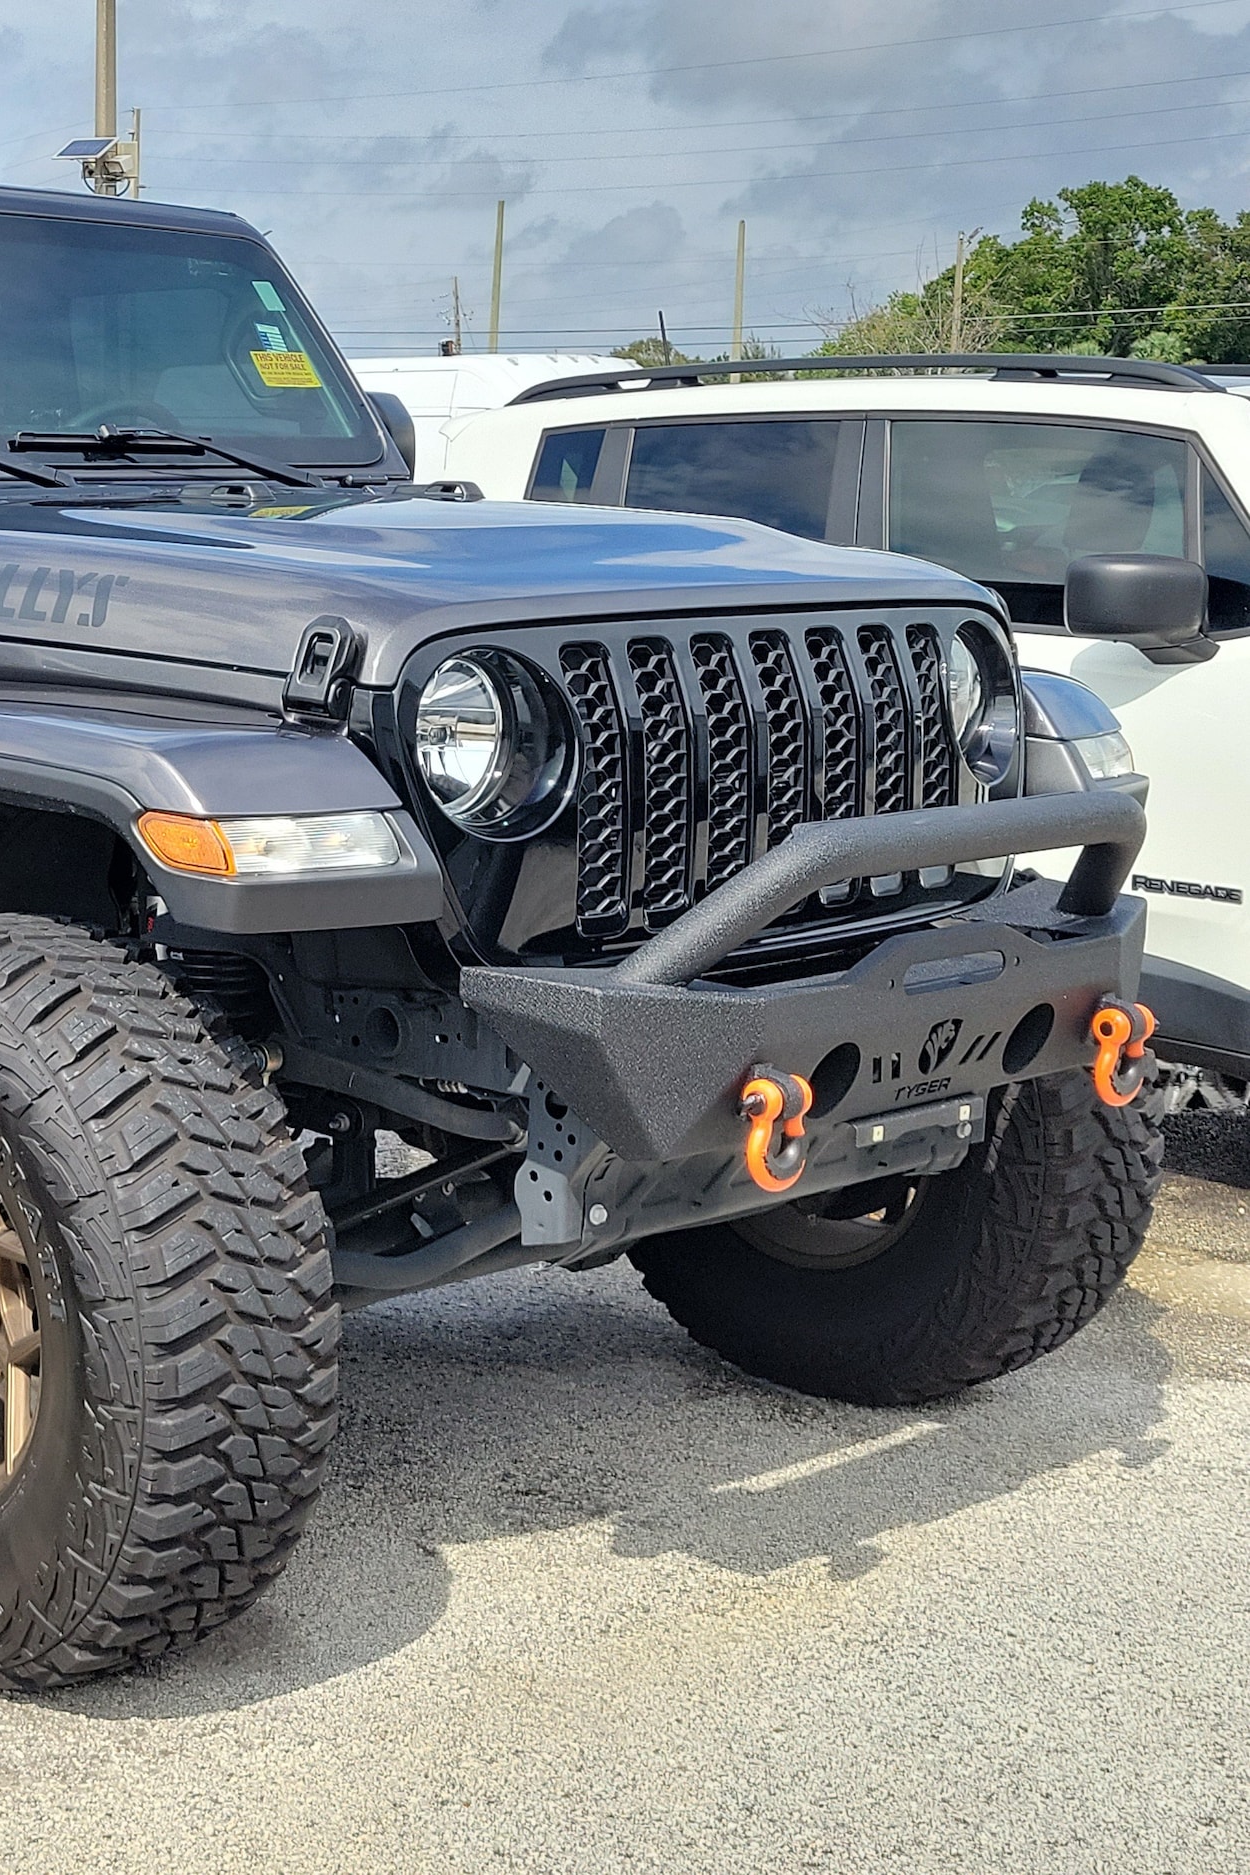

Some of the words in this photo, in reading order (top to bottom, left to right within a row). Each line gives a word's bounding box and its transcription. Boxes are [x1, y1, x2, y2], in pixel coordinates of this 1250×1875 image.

[253, 353, 274, 362] THIS
[273, 353, 305, 363] VEHICLE
[1132, 874, 1242, 904] RENEGADE
[894, 1077, 951, 1101] TYGER
